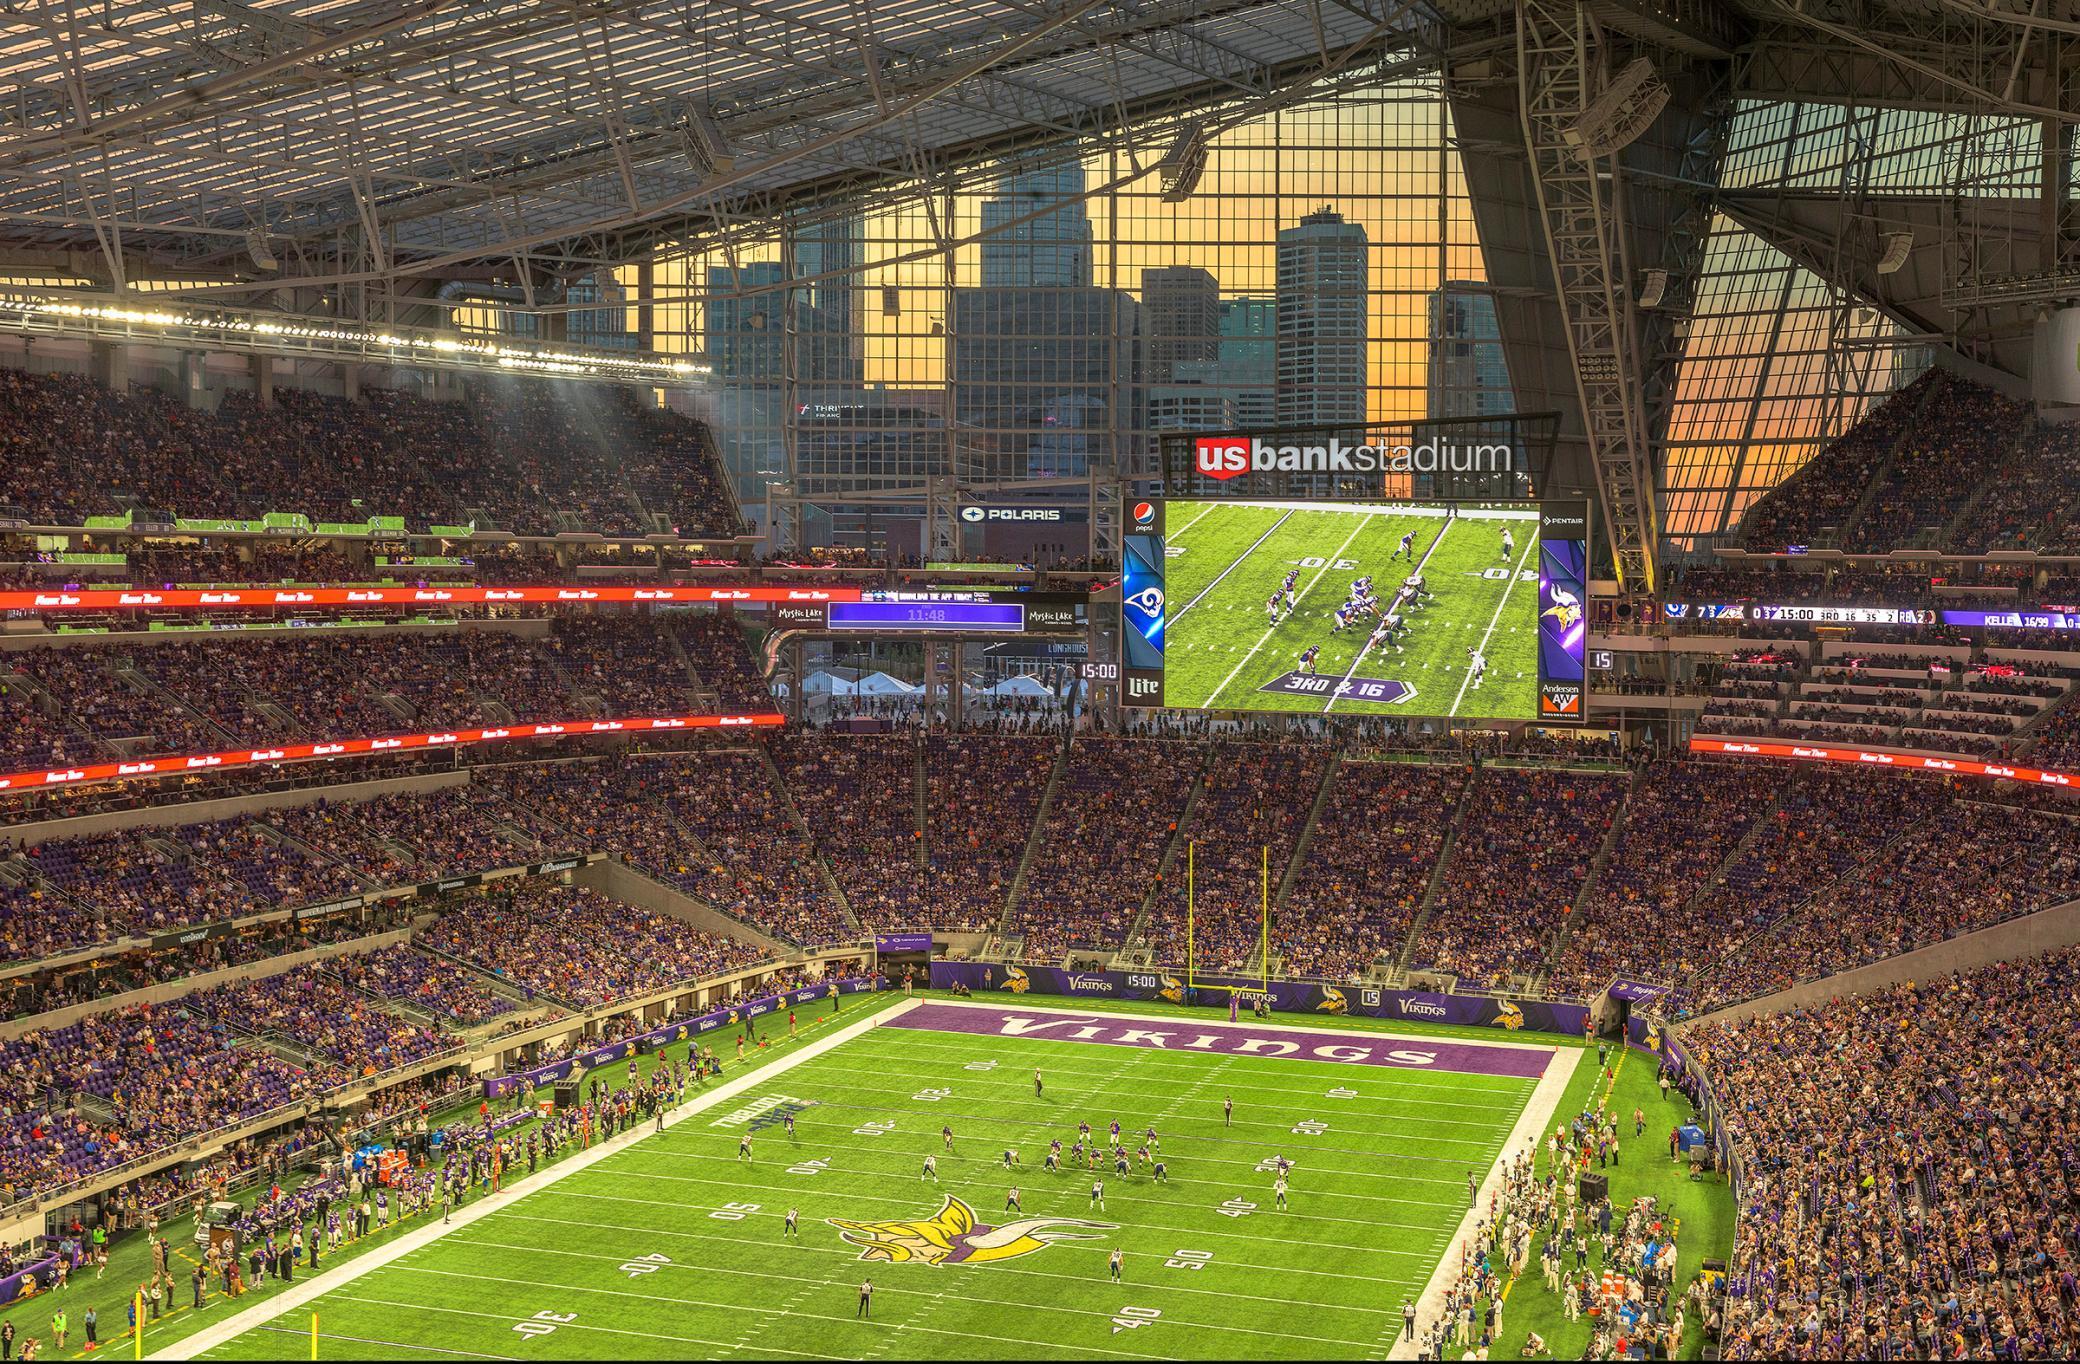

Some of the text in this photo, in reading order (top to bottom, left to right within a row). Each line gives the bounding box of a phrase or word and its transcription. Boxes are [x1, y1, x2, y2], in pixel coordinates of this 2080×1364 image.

[988, 509, 1060, 520] POLARIS
[908, 609, 945, 621] 11:48
[1698, 606, 1706, 618] 7
[1753, 608, 1761, 619] 0
[1780, 609, 1814, 620] 15:00
[1821, 612, 1839, 621] 3RD
[1845, 612, 1856, 621] 16
[1866, 613, 1877, 622] 35
[1887, 613, 1893, 622] 2
[2024, 616, 2048, 627] 16/99
[1596, 653, 1610, 668] 15
[1082, 663, 1116, 679] 15:00
[1128, 677, 1159, 698] Lite
[1284, 676, 1330, 692] 3RD
[1358, 682, 1385, 697] 16
[1542, 684, 1579, 693] Andersen
[1128, 975, 1155, 988] 15:00
[1367, 992, 1378, 1003] 15
[1000, 1015, 1437, 1066] VIKINGS
[852, 1119, 896, 1136] 30
[786, 1158, 829, 1175] 40
[708, 1202, 762, 1221] 50
[1215, 1200, 1258, 1218] 40
[618, 1253, 673, 1274] 40
[1162, 1248, 1216, 1271] 50
[511, 1310, 579, 1335] 30
[1110, 1306, 1162, 1329] 40
